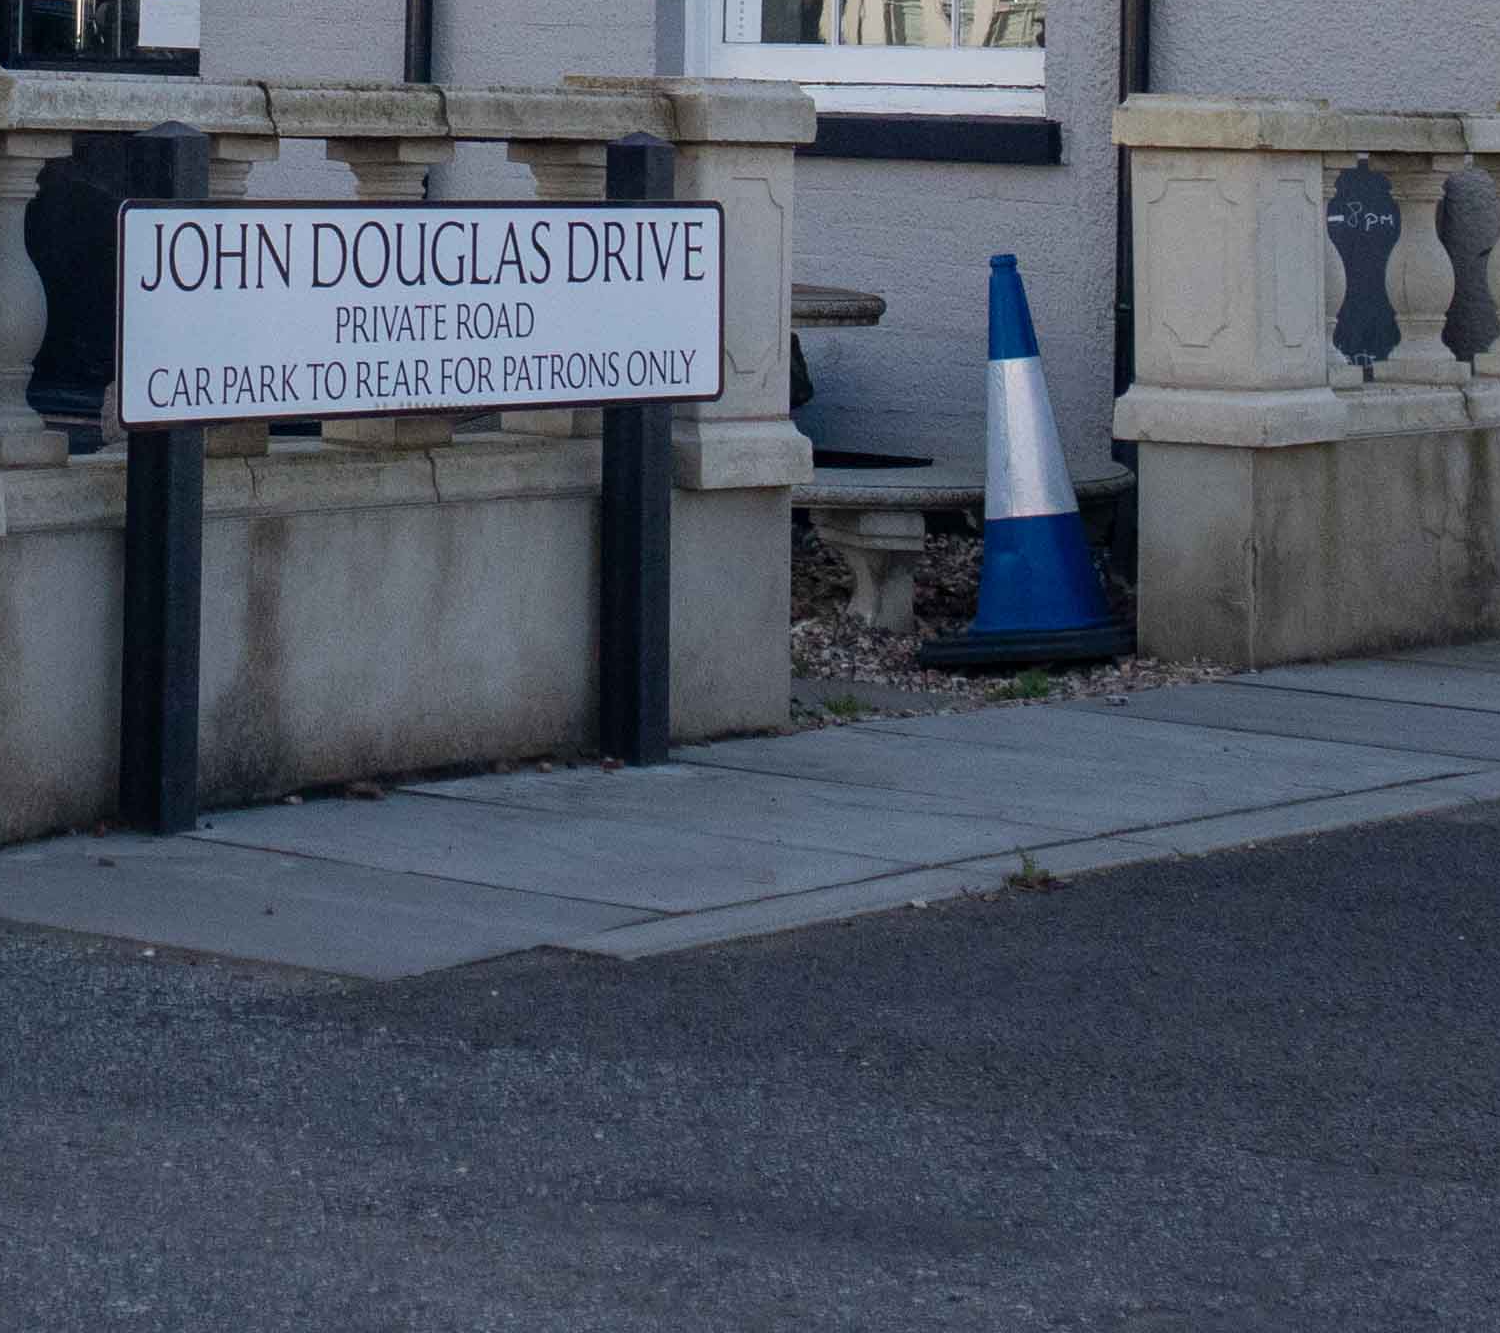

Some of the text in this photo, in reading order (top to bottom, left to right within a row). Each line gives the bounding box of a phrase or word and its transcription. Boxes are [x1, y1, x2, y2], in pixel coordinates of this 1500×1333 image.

[140, 220, 705, 292] JOHN DOUGLAS DRIVE
[335, 301, 535, 344] PRIVATE ROAD
[147, 349, 697, 409] CAR PARK TO REAR FOR PATRONS ONLY
